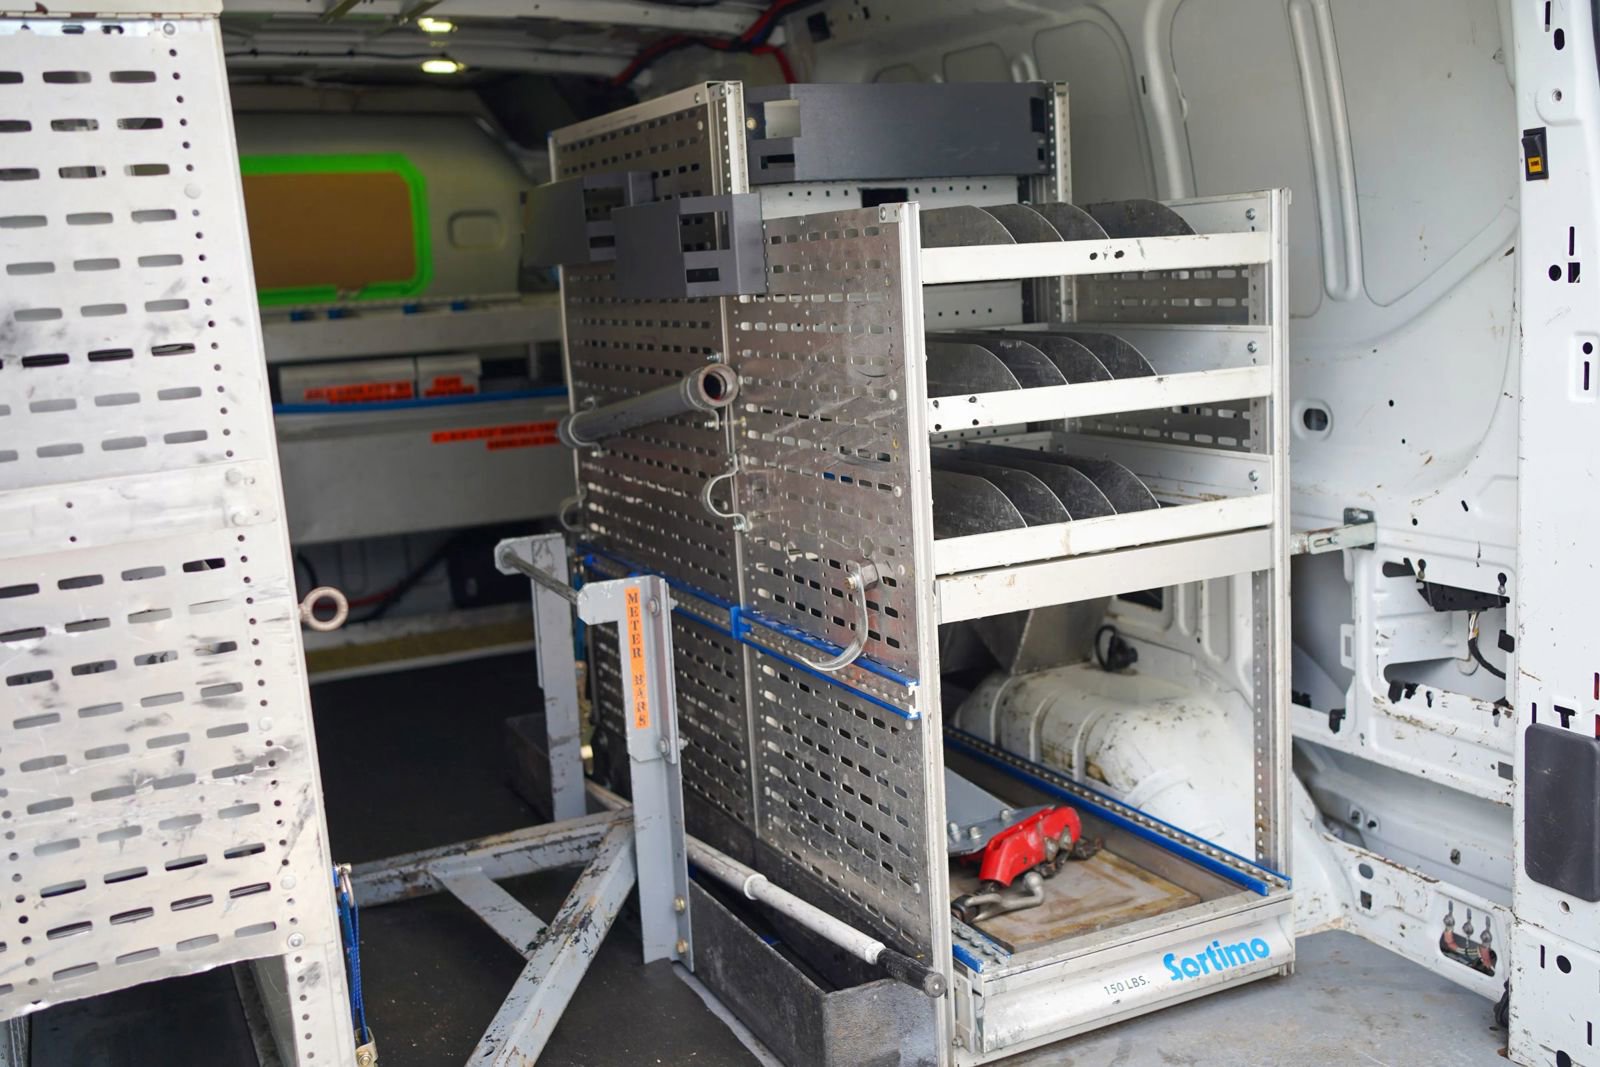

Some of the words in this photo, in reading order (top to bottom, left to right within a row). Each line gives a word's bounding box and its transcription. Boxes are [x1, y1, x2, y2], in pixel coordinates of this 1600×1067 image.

[627, 592, 642, 658] METER
[635, 674, 647, 726] BARS
[1163, 937, 1270, 982] Sortimo
[1103, 982, 1125, 996] 150
[1126, 975, 1151, 993] LBS.
